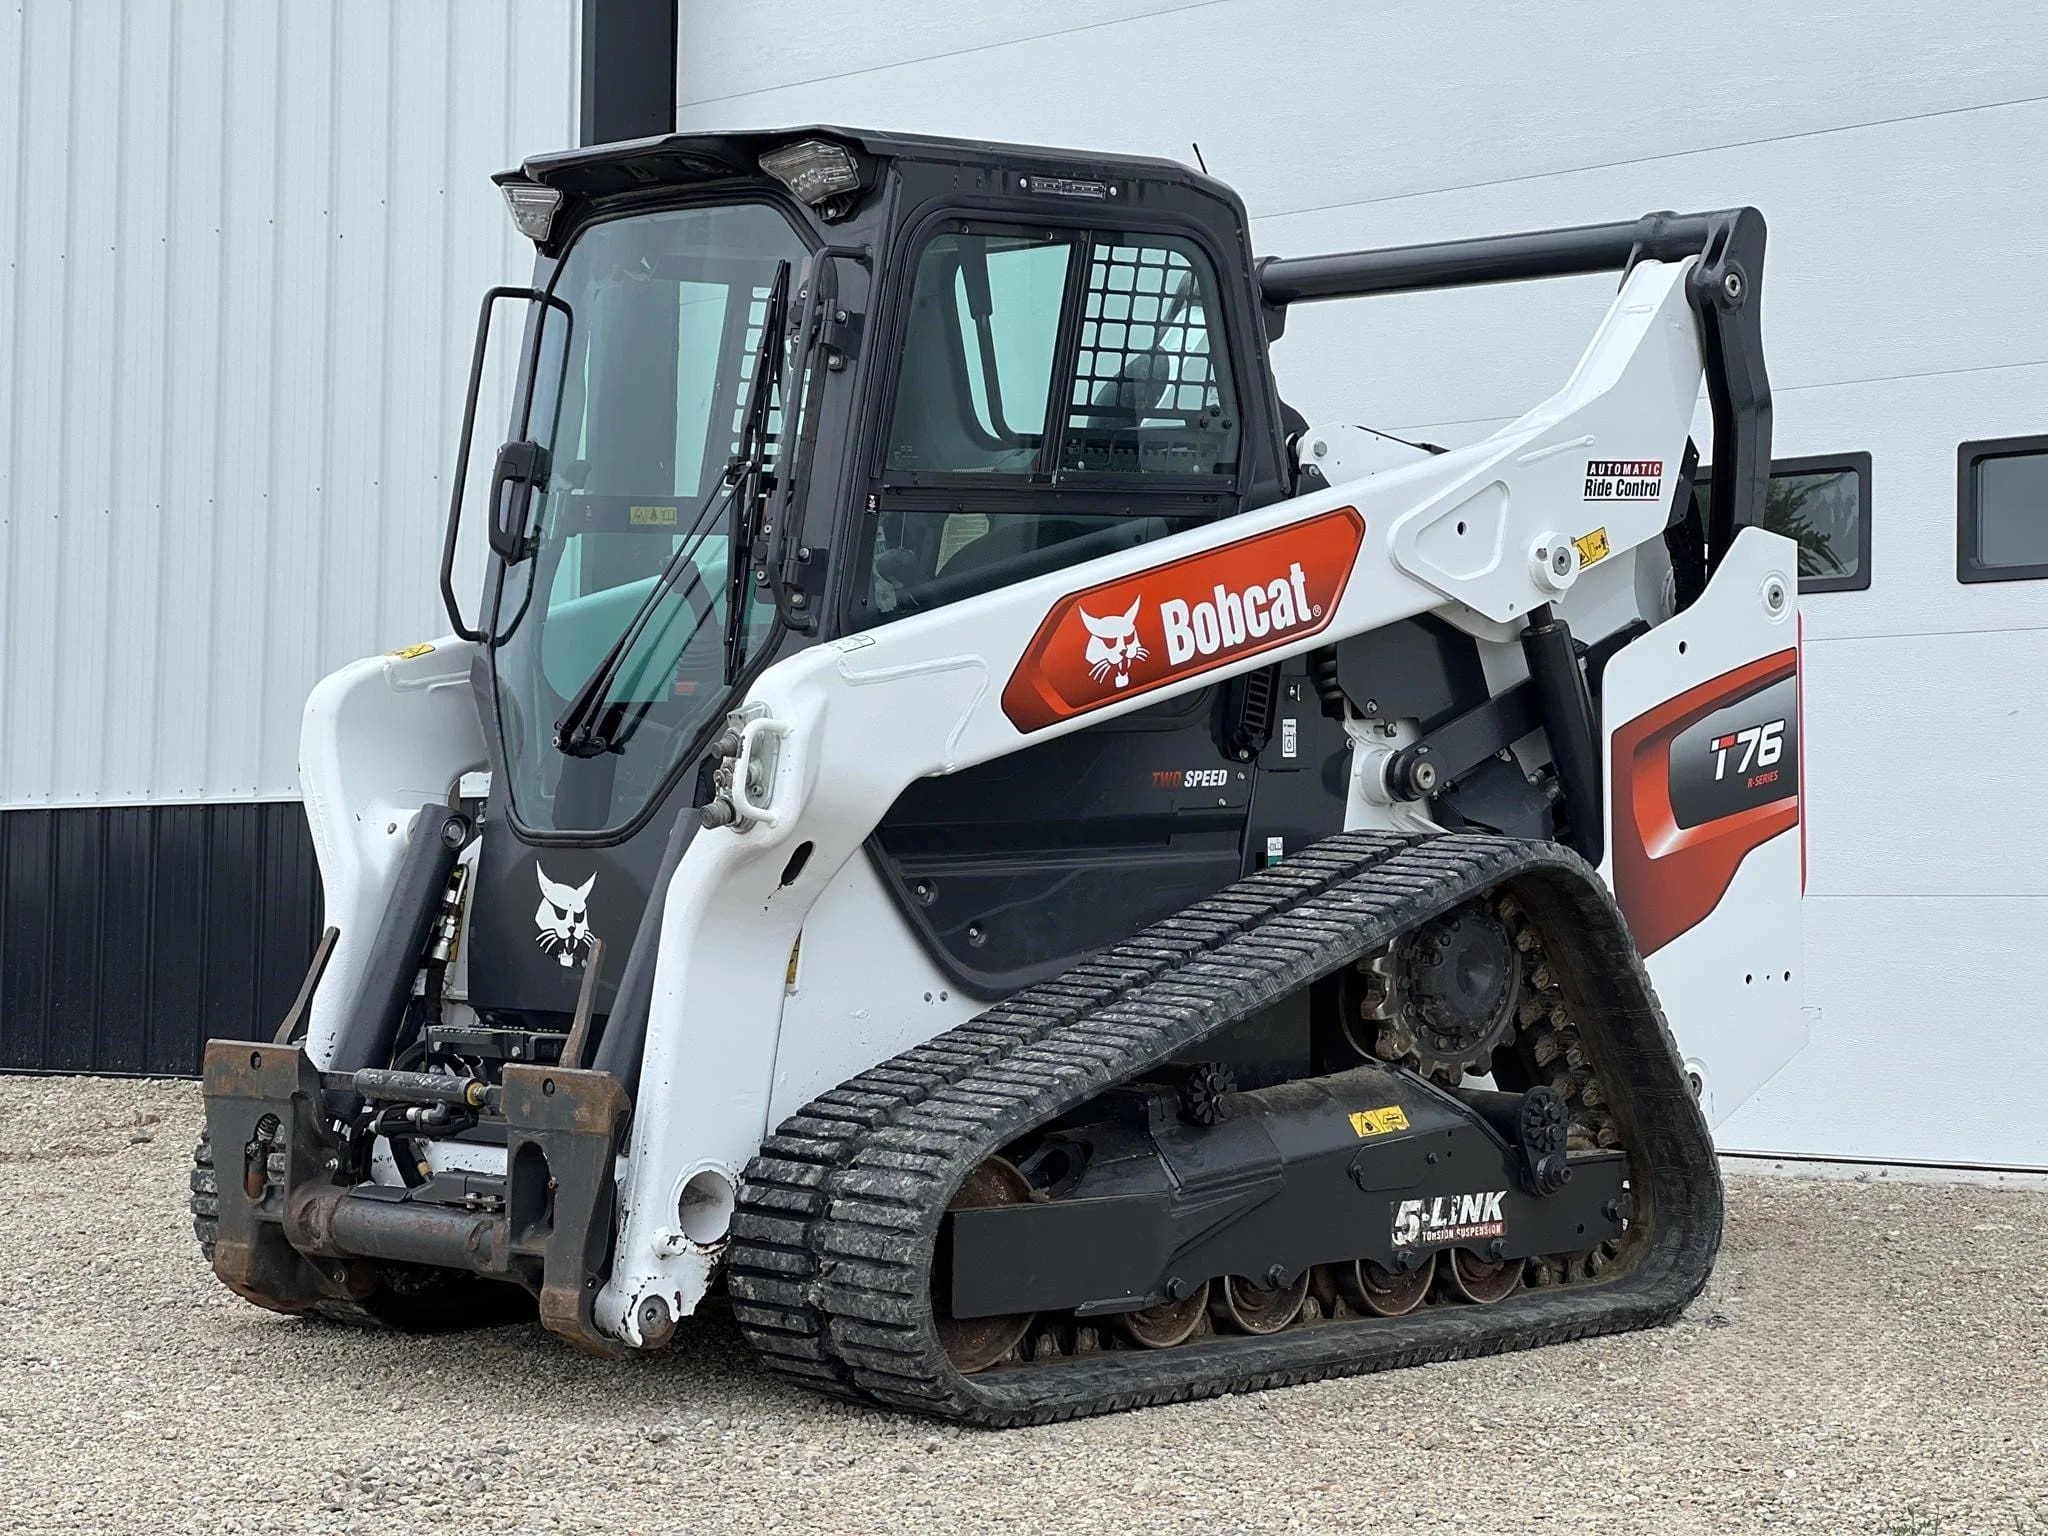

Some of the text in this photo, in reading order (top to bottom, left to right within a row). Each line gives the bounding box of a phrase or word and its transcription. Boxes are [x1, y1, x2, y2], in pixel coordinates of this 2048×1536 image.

[1589, 463, 1661, 475] AUTOMATIC
[1584, 479, 1661, 496] Ride Control
[1711, 719, 1785, 780] T76
[1152, 769, 1228, 787] TWO SPEED
[1747, 770, 1779, 788] R-SERIES
[1456, 1222, 1501, 1240] SUSPENSION
